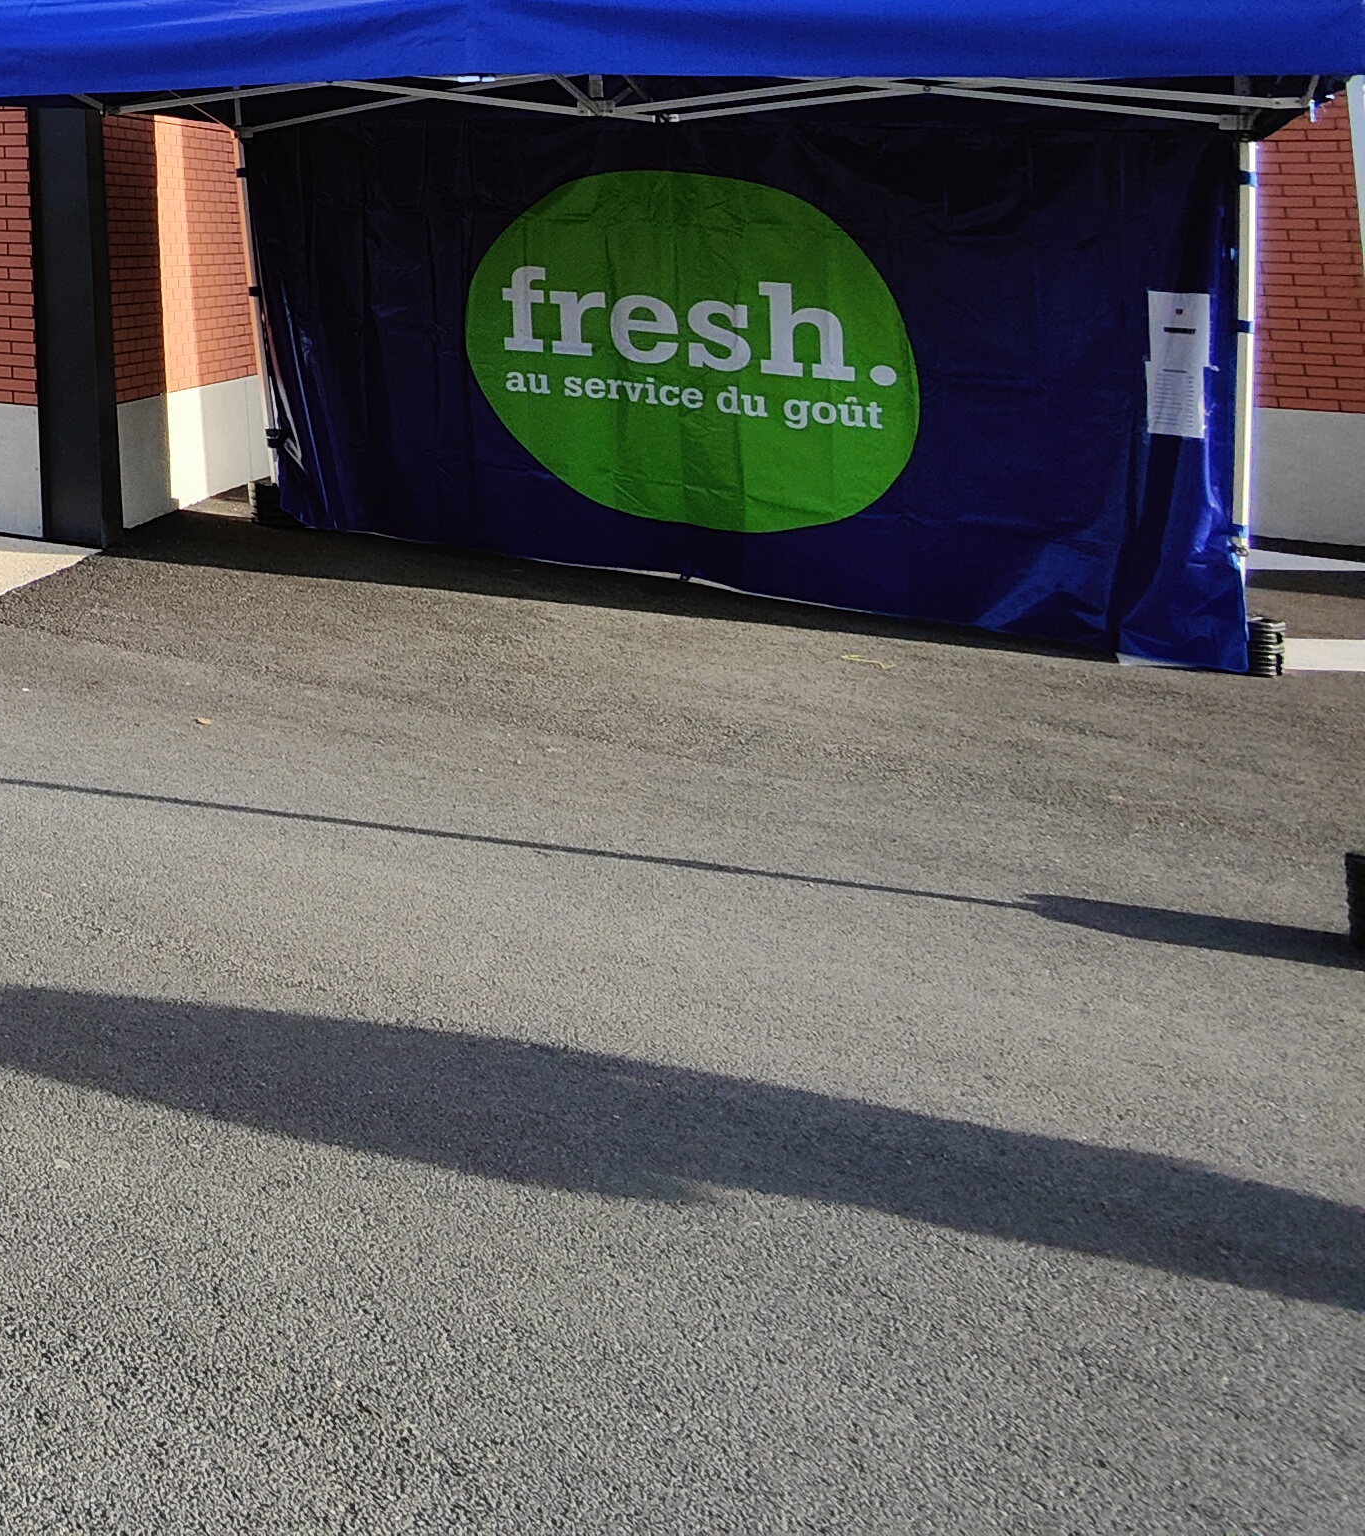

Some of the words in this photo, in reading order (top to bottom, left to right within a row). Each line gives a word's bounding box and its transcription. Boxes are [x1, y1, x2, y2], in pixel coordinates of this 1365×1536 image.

[501, 265, 897, 387] fresh.
[506, 371, 551, 394] au
[563, 376, 703, 409] service
[716, 385, 768, 418] du
[783, 396, 884, 430] goût
